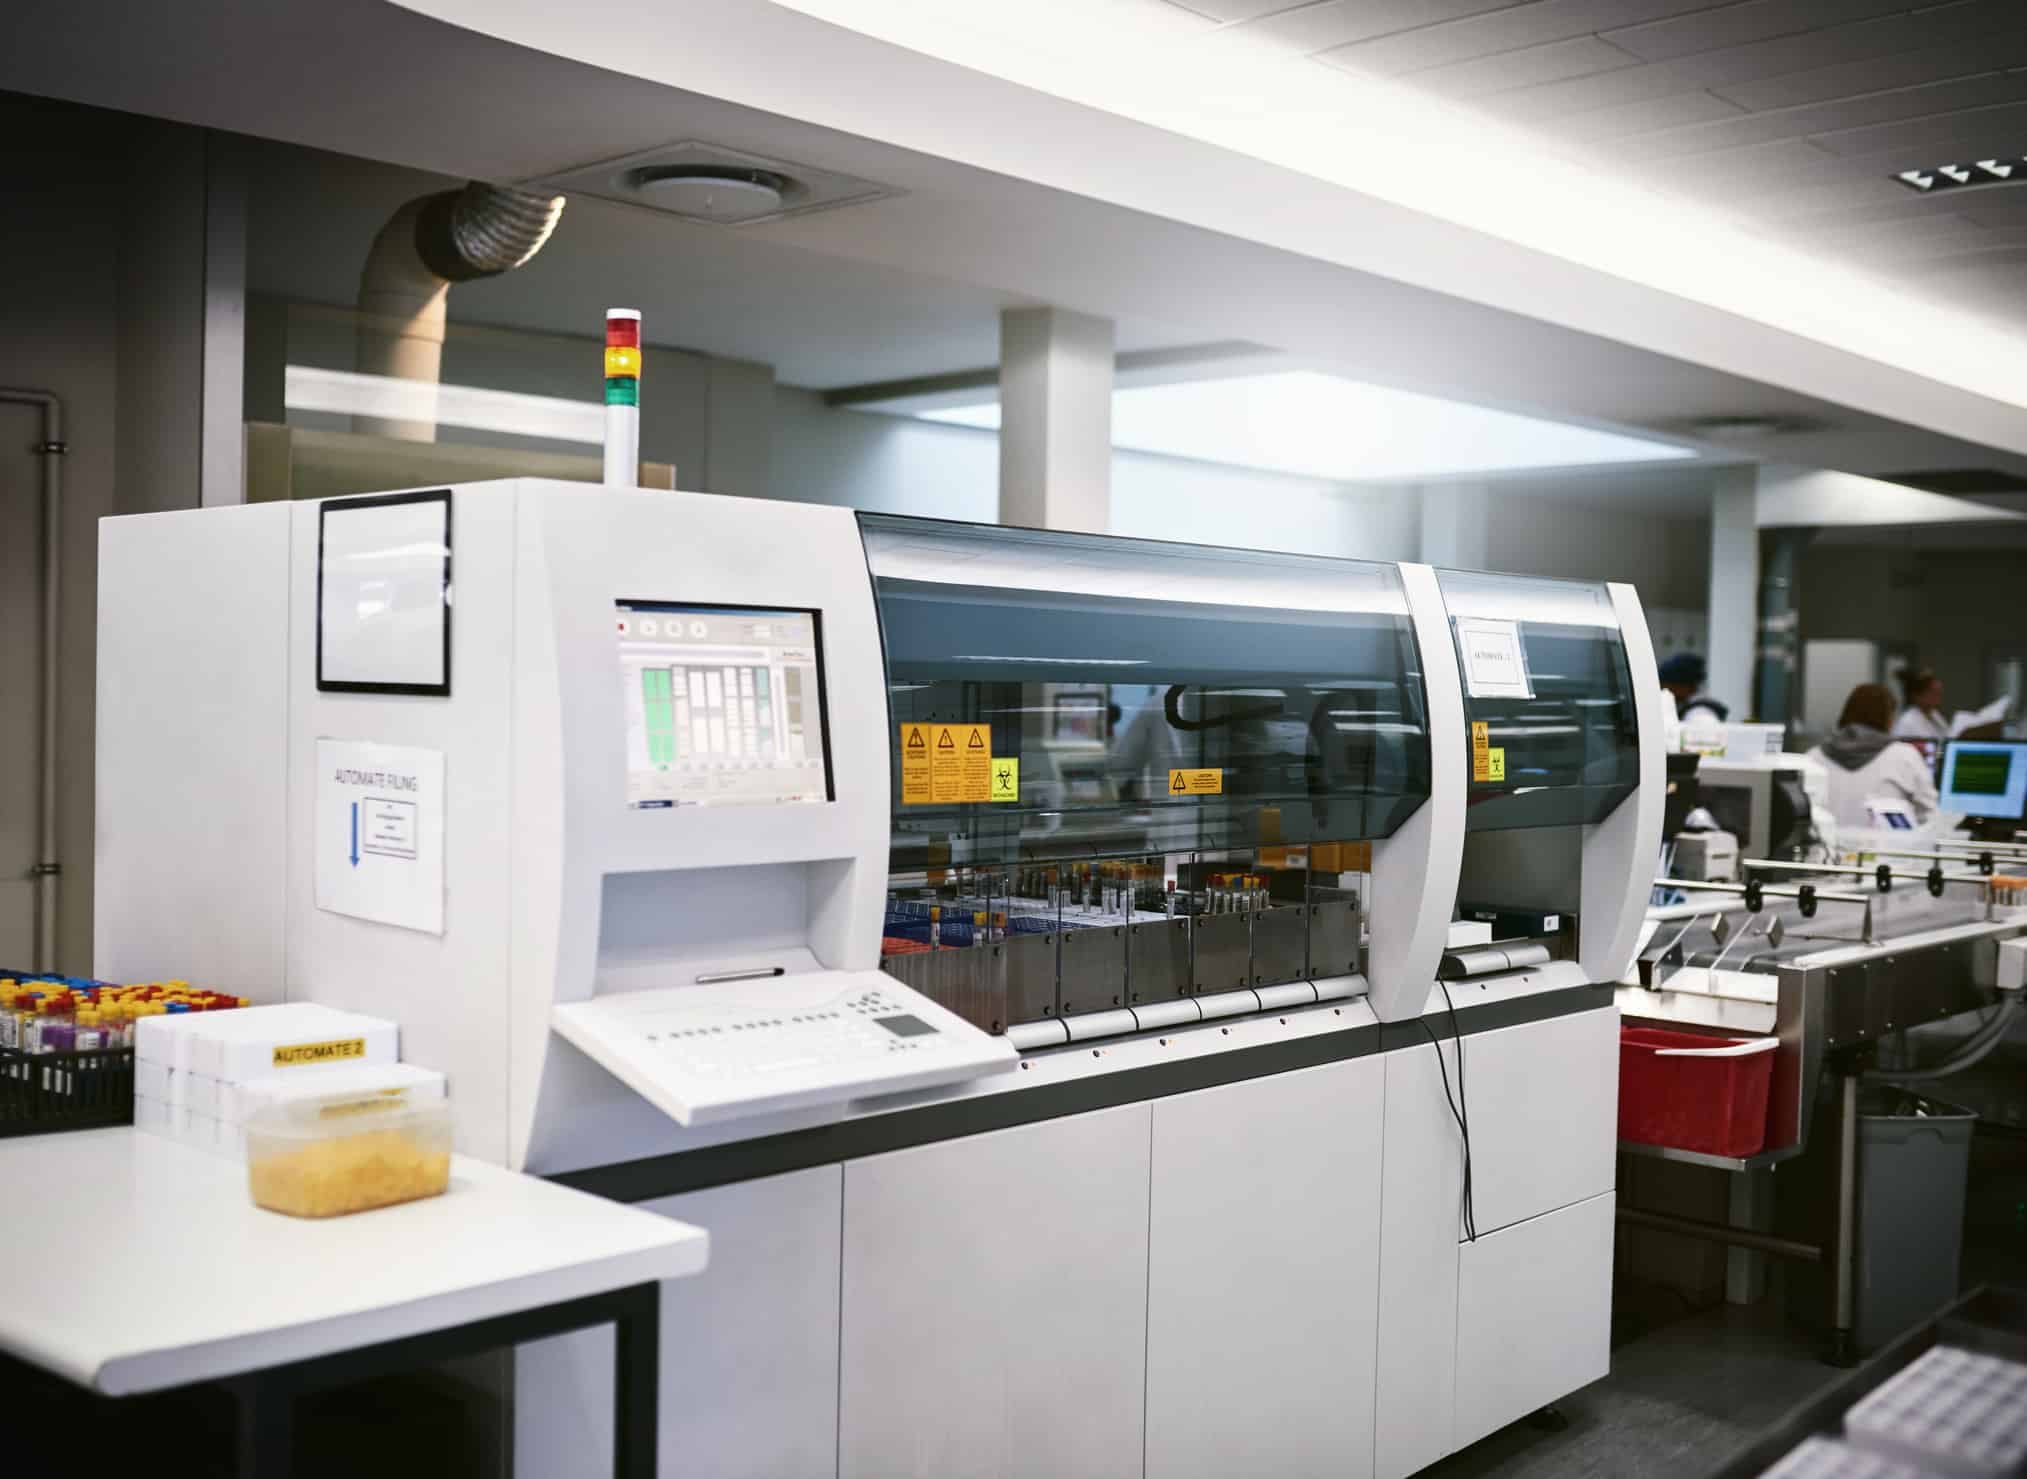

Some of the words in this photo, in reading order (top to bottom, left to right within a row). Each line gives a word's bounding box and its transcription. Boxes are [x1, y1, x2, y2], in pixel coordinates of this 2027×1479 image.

[335, 768, 385, 788] AUTOMATE
[386, 773, 417, 792] FILING
[273, 1043, 353, 1064] AUTOMATE
[353, 1041, 363, 1055] 2
